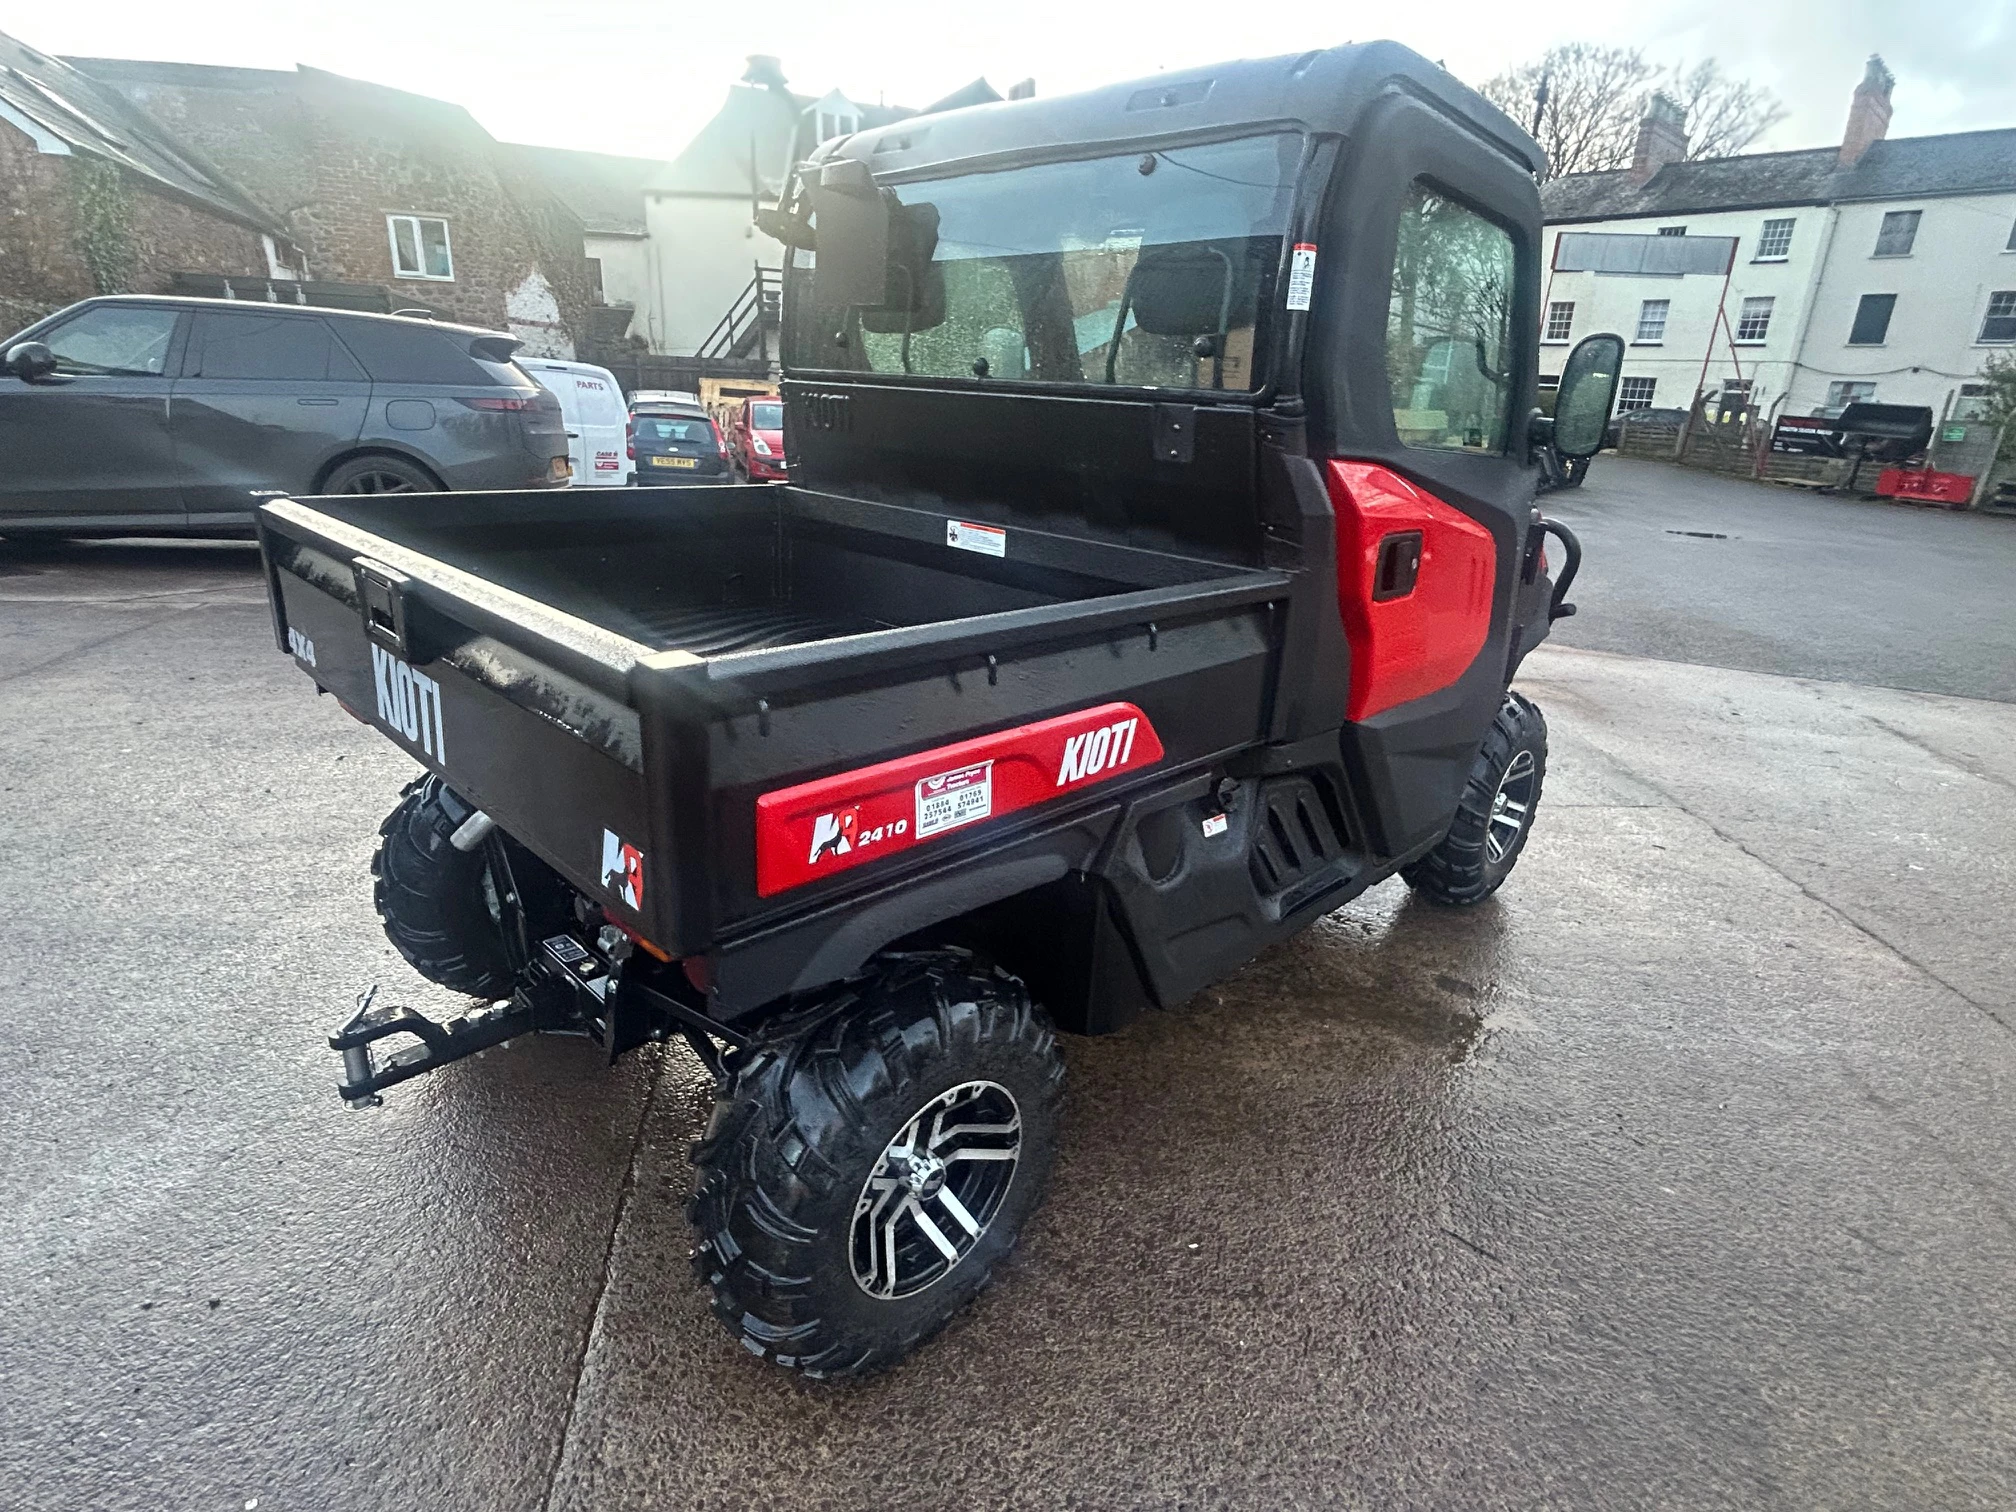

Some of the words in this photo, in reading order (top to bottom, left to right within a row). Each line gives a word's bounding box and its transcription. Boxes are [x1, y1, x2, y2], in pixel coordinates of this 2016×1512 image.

[576, 380, 604, 391] PARTS
[371, 642, 446, 767] KIOTI
[1056, 717, 1138, 787] KIOTI
[959, 789, 982, 801] 01769
[926, 799, 950, 812] 01884
[957, 796, 984, 809] 574941
[924, 806, 952, 820] 257544
[858, 819, 908, 847] 2410
